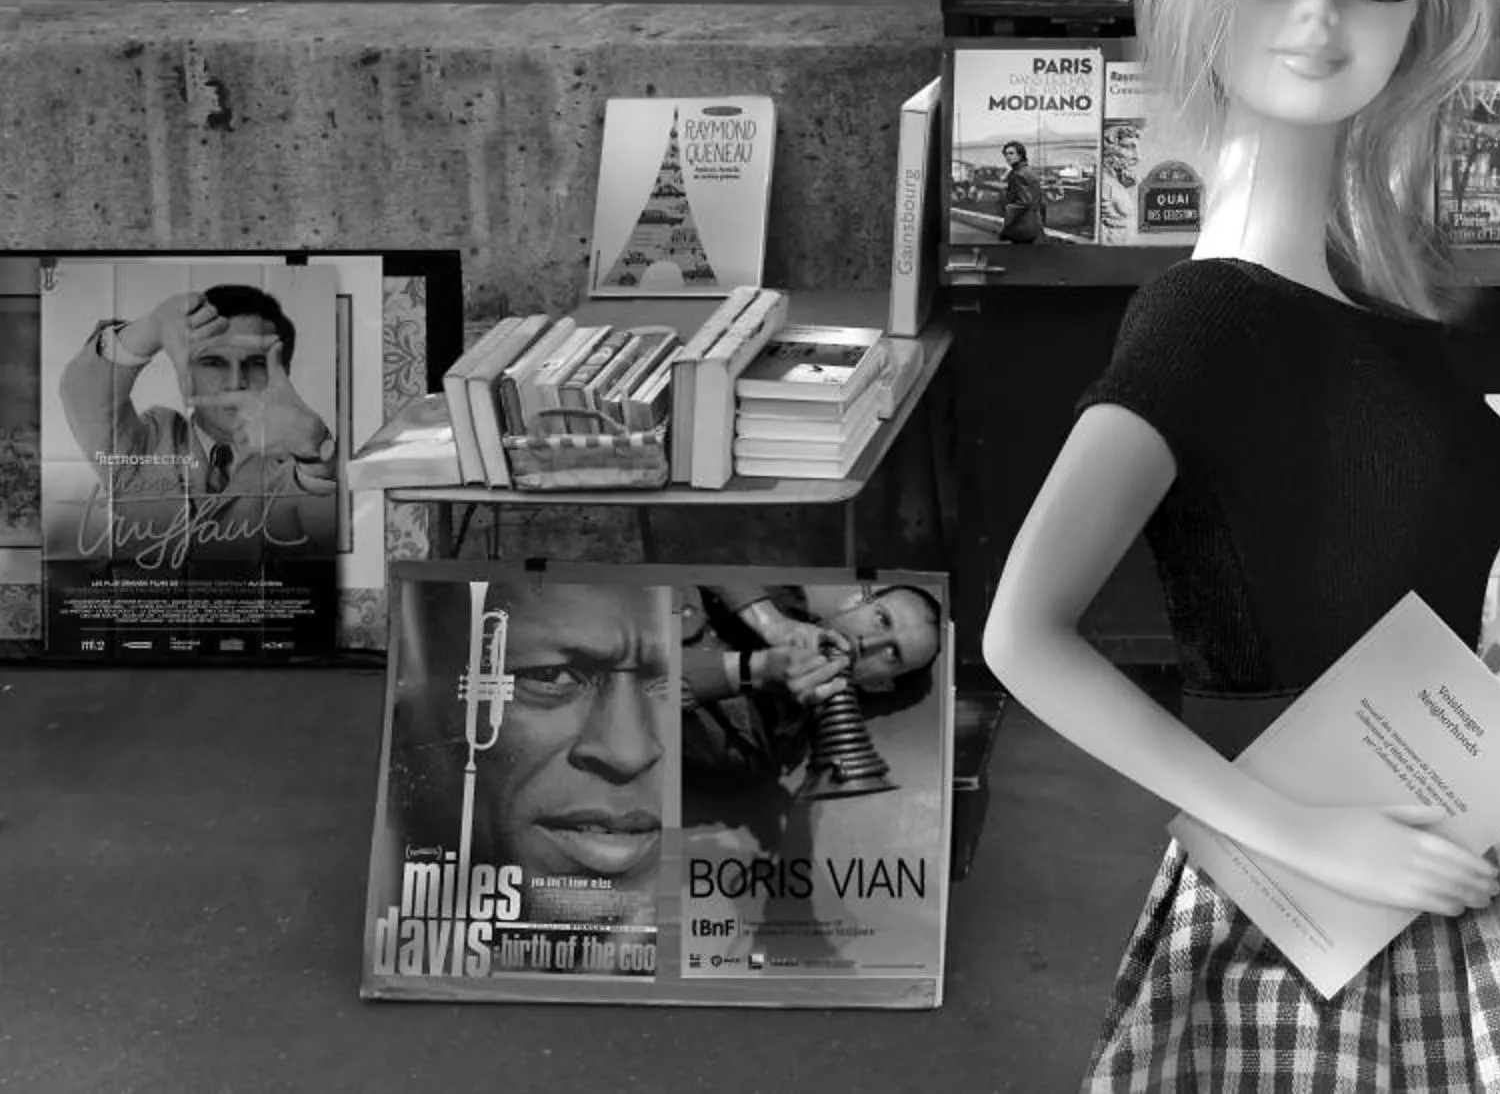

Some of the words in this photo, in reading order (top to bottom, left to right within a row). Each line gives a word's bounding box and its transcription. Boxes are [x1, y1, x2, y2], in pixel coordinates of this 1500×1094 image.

[1033, 57, 1093, 75] PARIS
[988, 94, 1093, 111] MODIANO
[684, 118, 758, 140] RAYMOND
[684, 141, 753, 167] QUENEAU
[1157, 192, 1190, 206] QUAI
[402, 851, 523, 921] miles
[689, 857, 814, 900] BORIS
[827, 857, 926, 900] VIAN
[373, 906, 494, 978] davis
[501, 934, 551, 969] birth
[555, 935, 579, 970] of
[582, 935, 616, 970] the
[619, 942, 657, 972] coo
